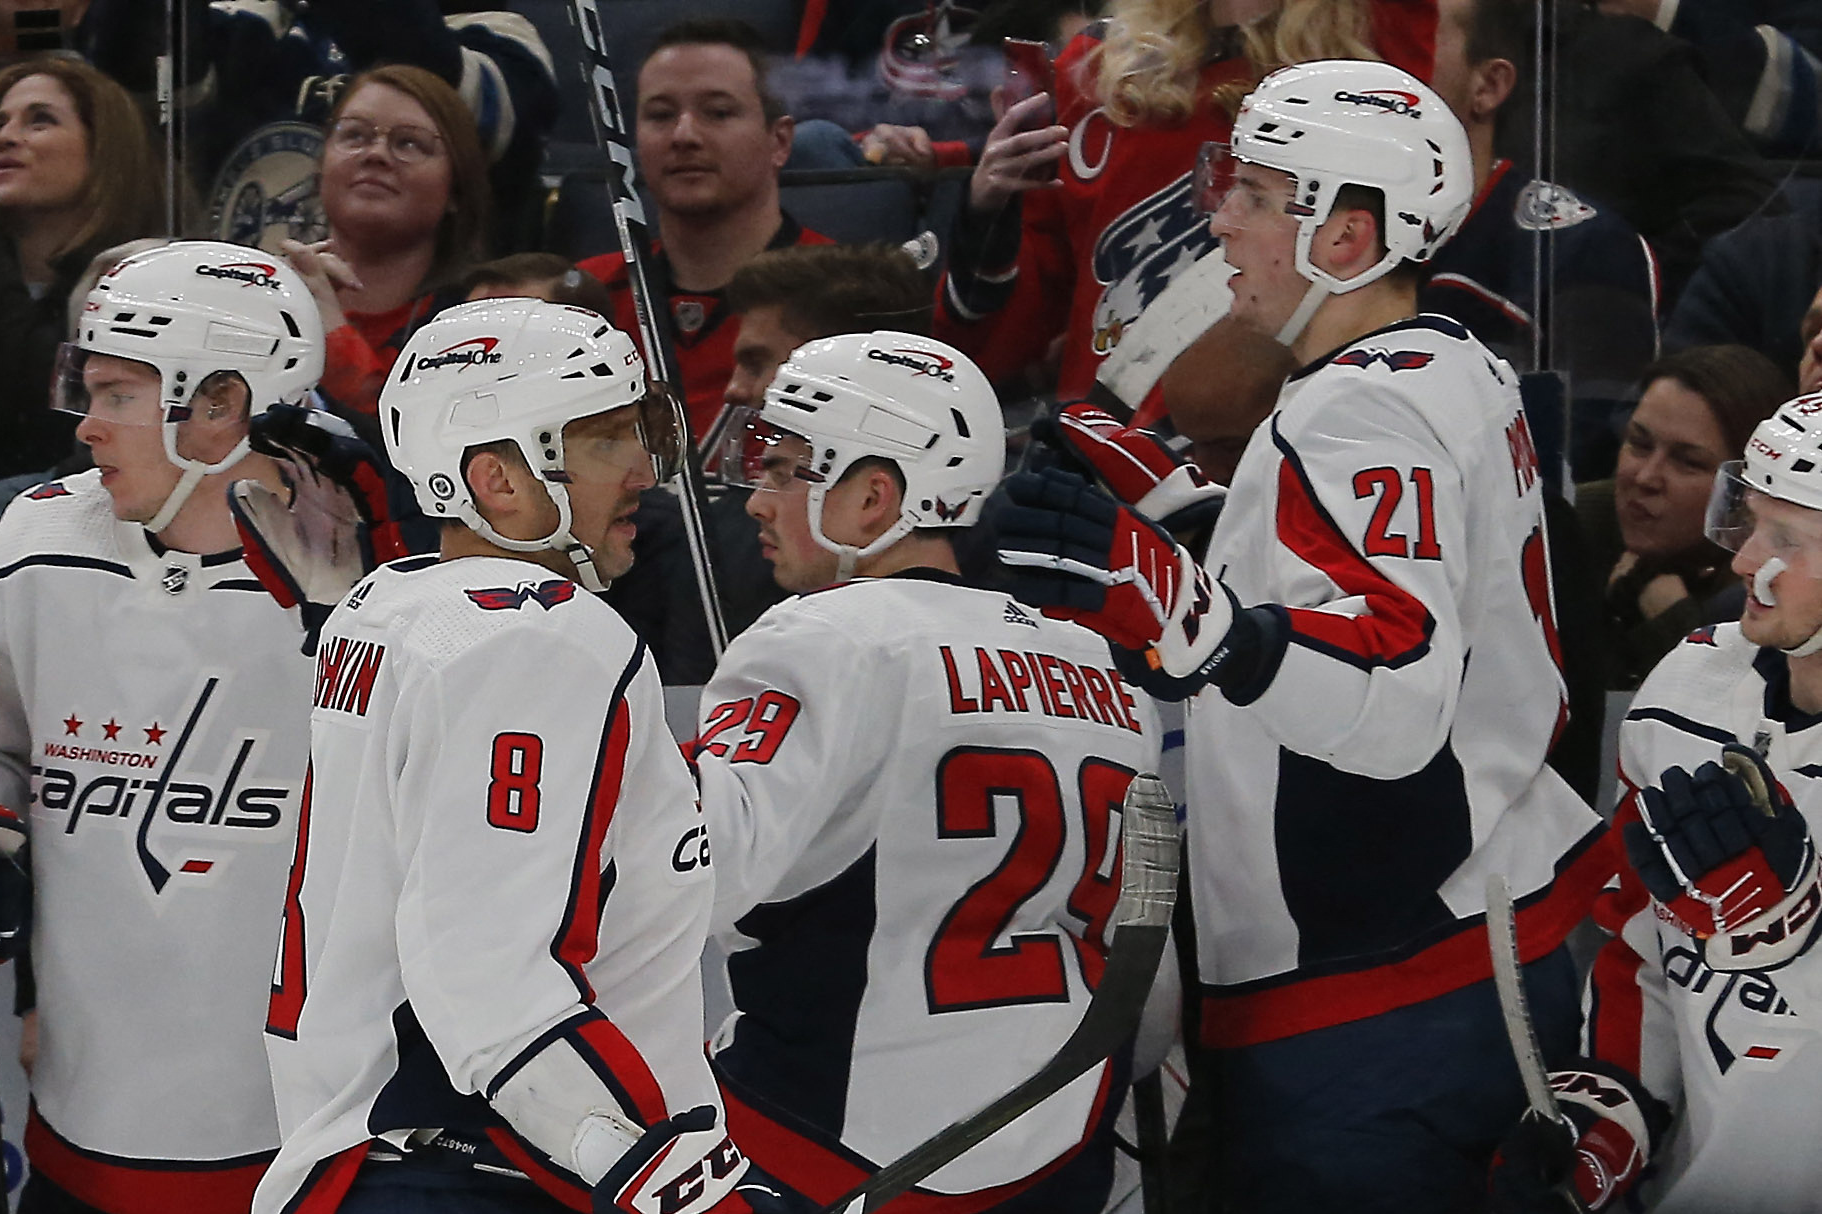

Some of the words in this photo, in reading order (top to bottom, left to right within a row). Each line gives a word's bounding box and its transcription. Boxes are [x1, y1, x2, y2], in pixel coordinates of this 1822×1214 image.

[1352, 466, 1442, 561] 21
[696, 689, 802, 765] 29
[938, 643, 1142, 736] LAPIERRE
[44, 742, 159, 769] WASHINGTON
[486, 731, 544, 834] 8
